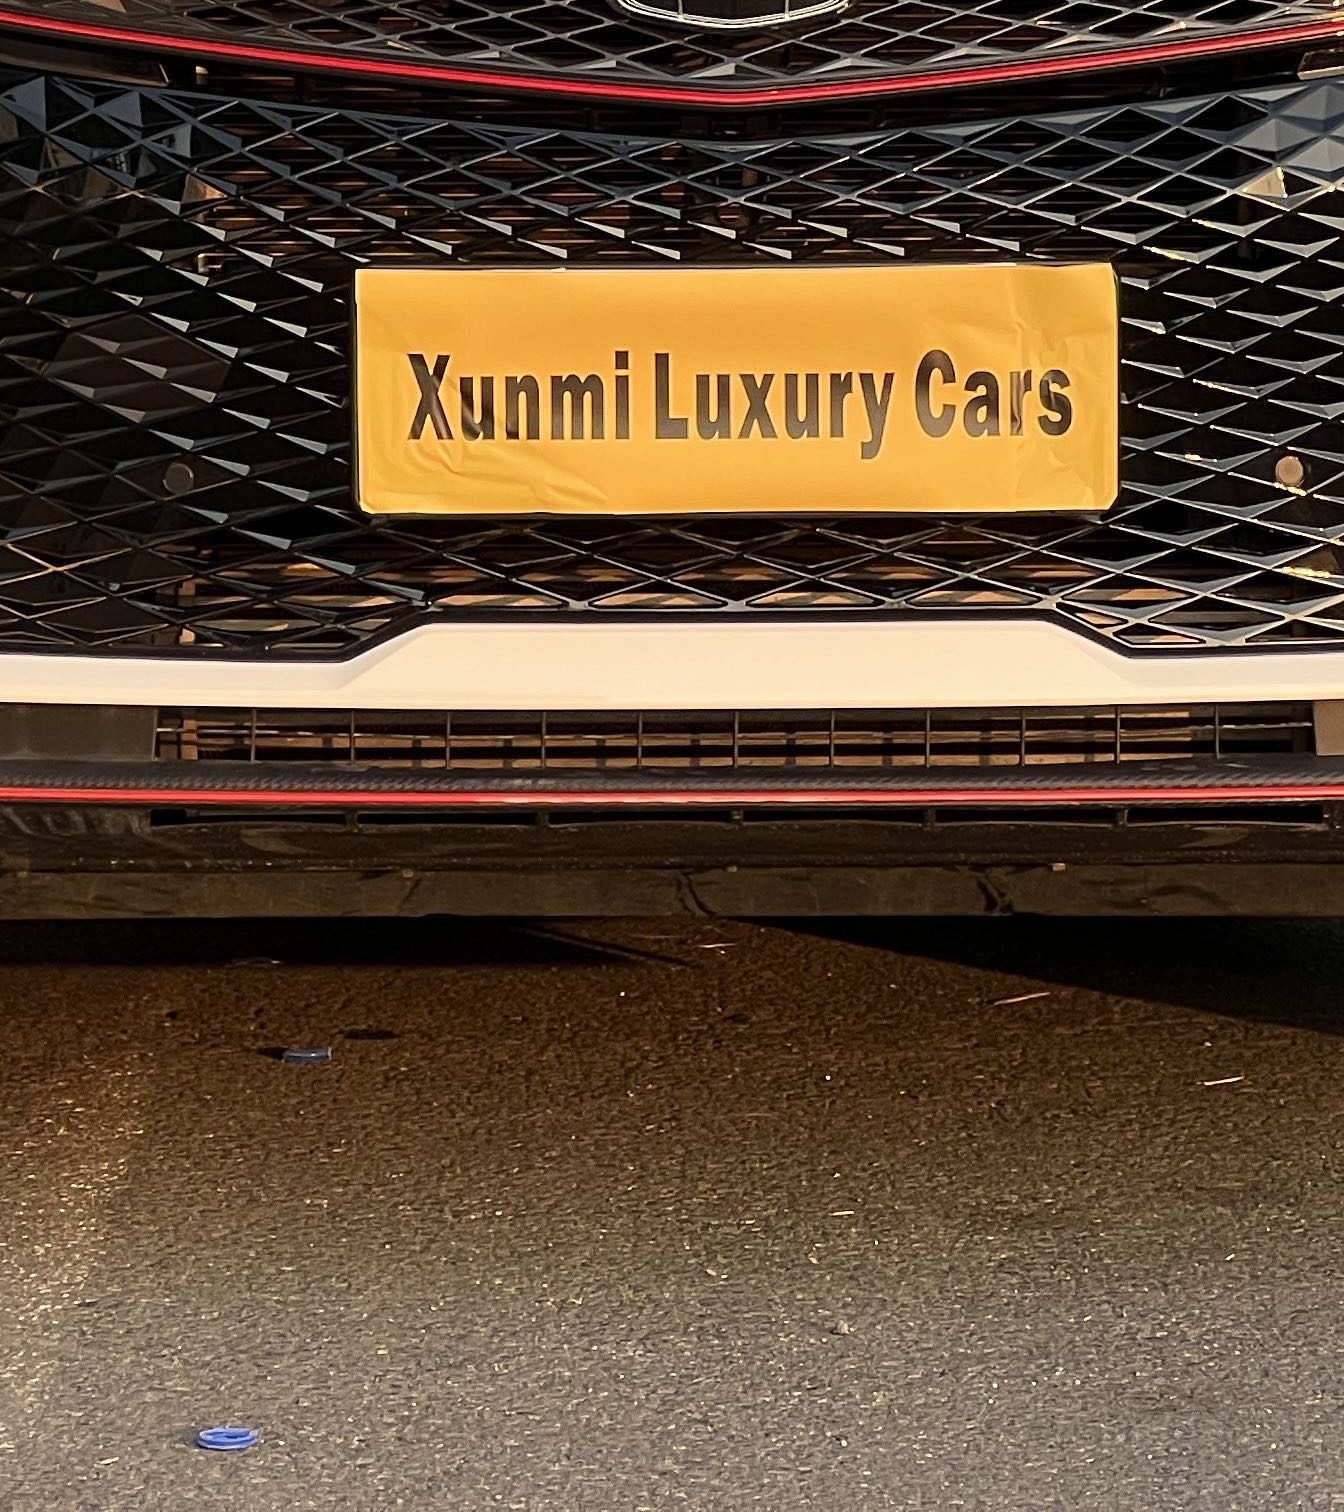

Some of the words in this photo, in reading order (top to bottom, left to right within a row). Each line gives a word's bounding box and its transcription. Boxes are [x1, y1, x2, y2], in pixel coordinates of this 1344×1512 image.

[406, 350, 631, 442] Xunmi
[654, 352, 896, 461] Luxury
[913, 348, 1074, 439] Cars
